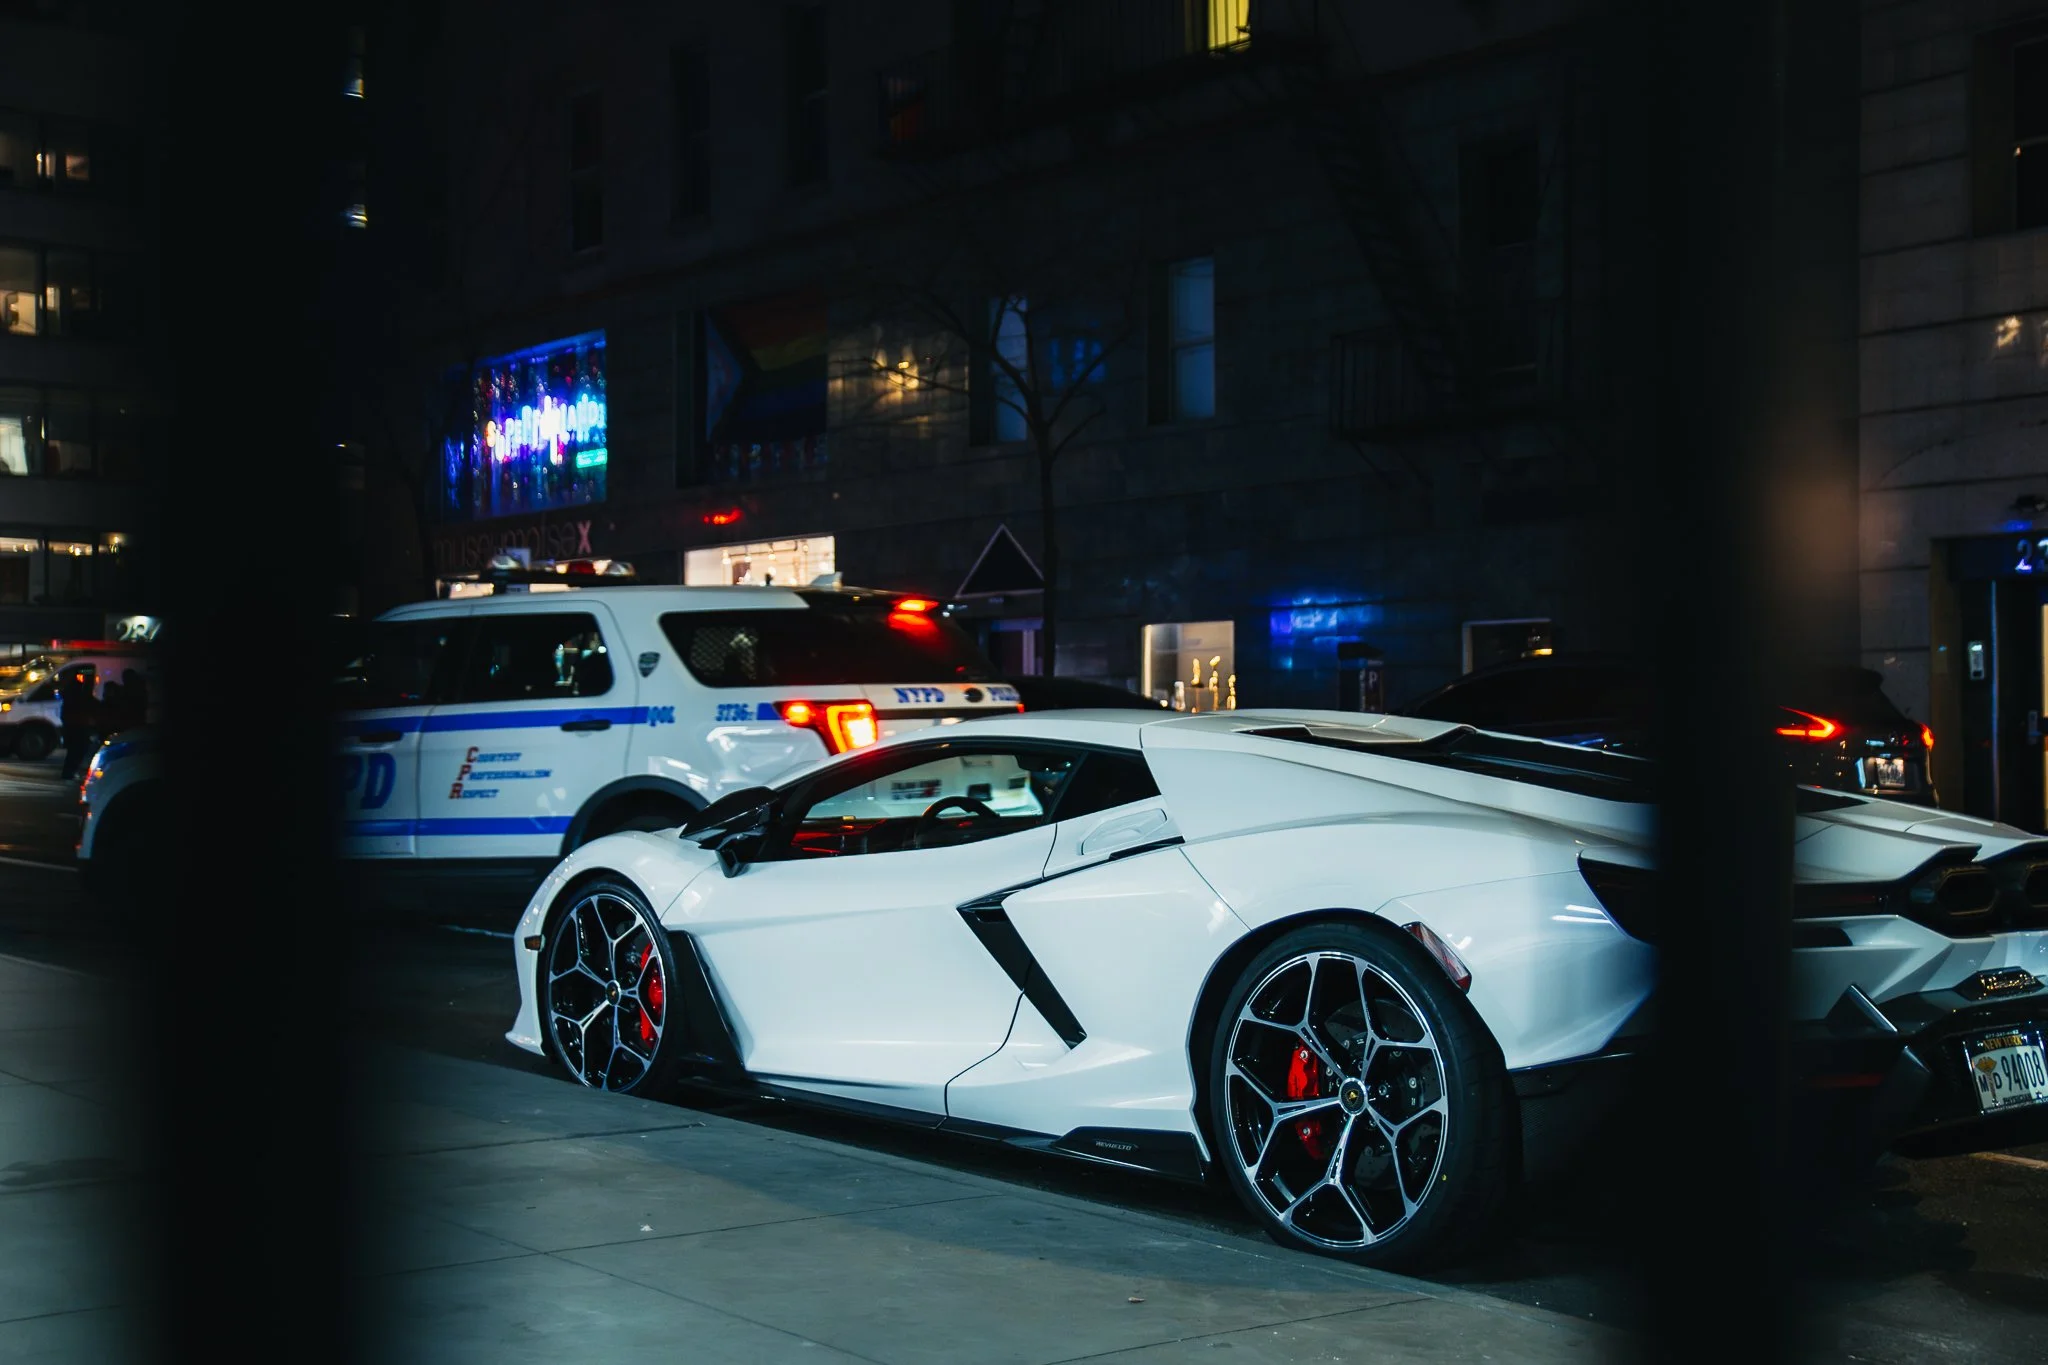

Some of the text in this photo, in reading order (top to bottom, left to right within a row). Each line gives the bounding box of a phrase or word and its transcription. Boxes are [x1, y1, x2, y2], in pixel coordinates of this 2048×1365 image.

[893, 687, 945, 703] NYPD
[1983, 1037, 2003, 1050] NEW
[2001, 1034, 2023, 1047] YORK
